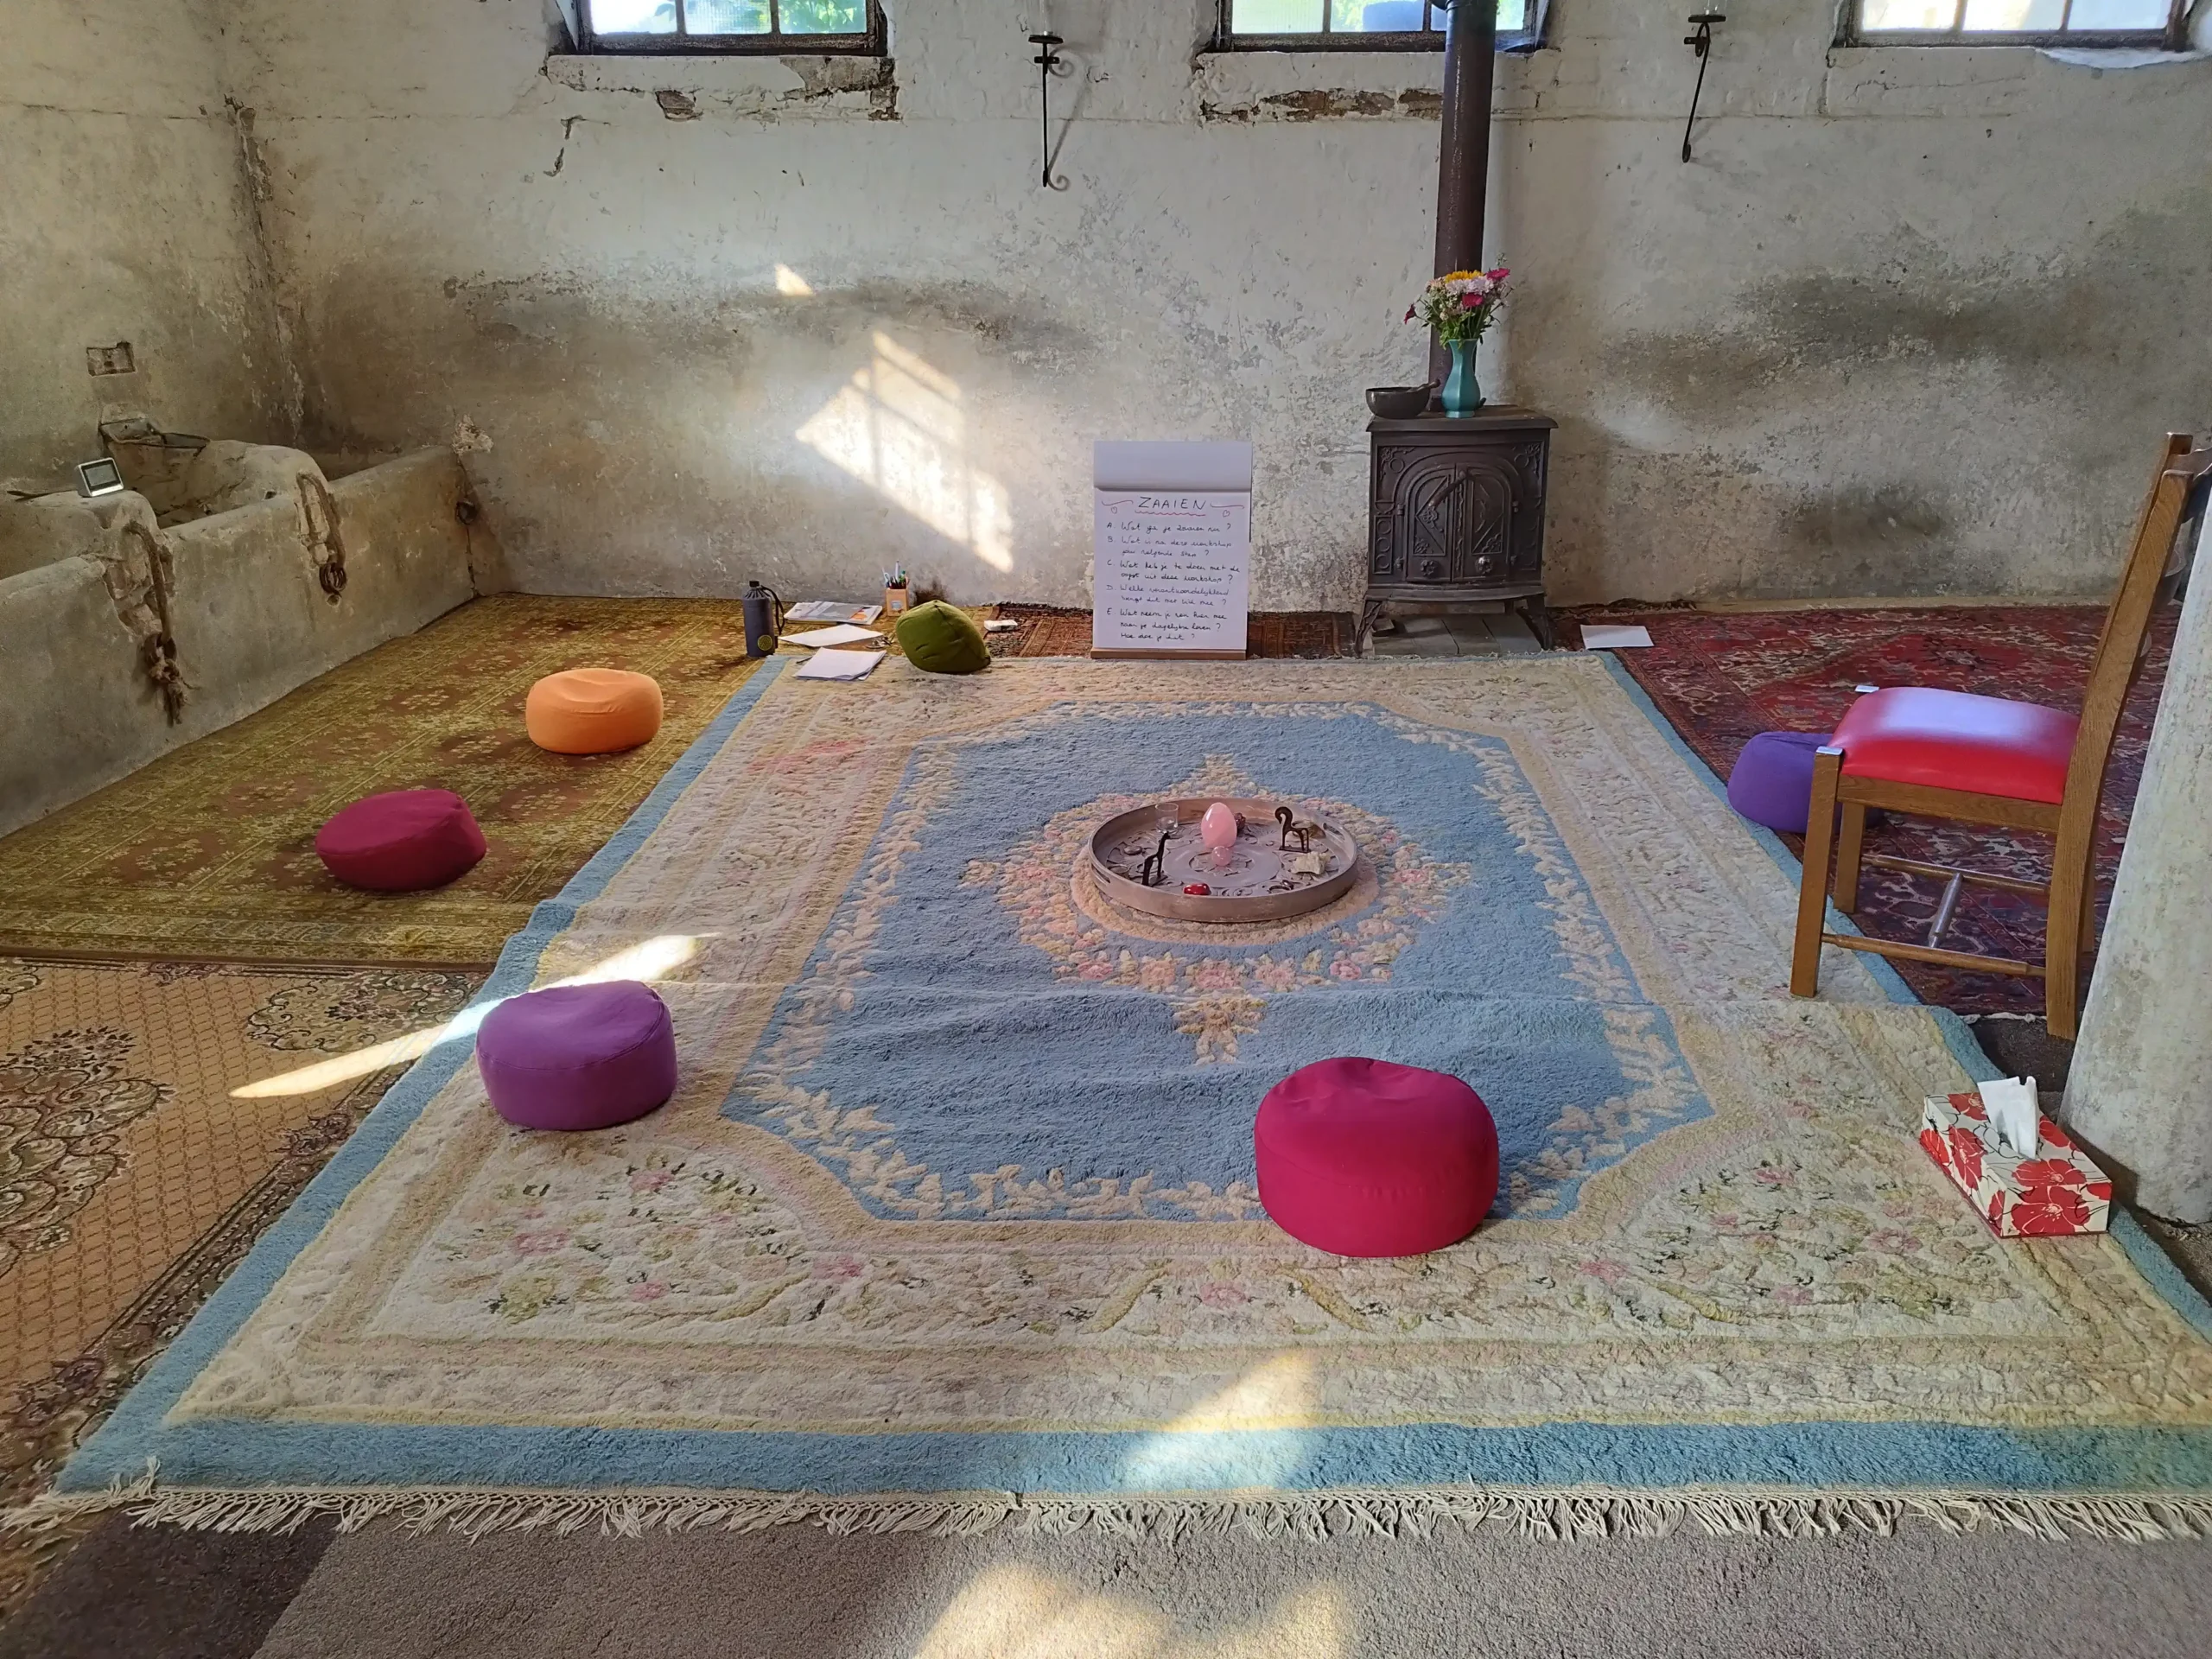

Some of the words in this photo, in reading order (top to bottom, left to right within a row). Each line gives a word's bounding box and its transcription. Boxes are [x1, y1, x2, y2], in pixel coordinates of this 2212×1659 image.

[1139, 496, 1206, 510] ZAAIEN
[1122, 521, 1141, 531] Wat
[1163, 525, 1172, 534] je
[1120, 560, 1138, 569] Wat
